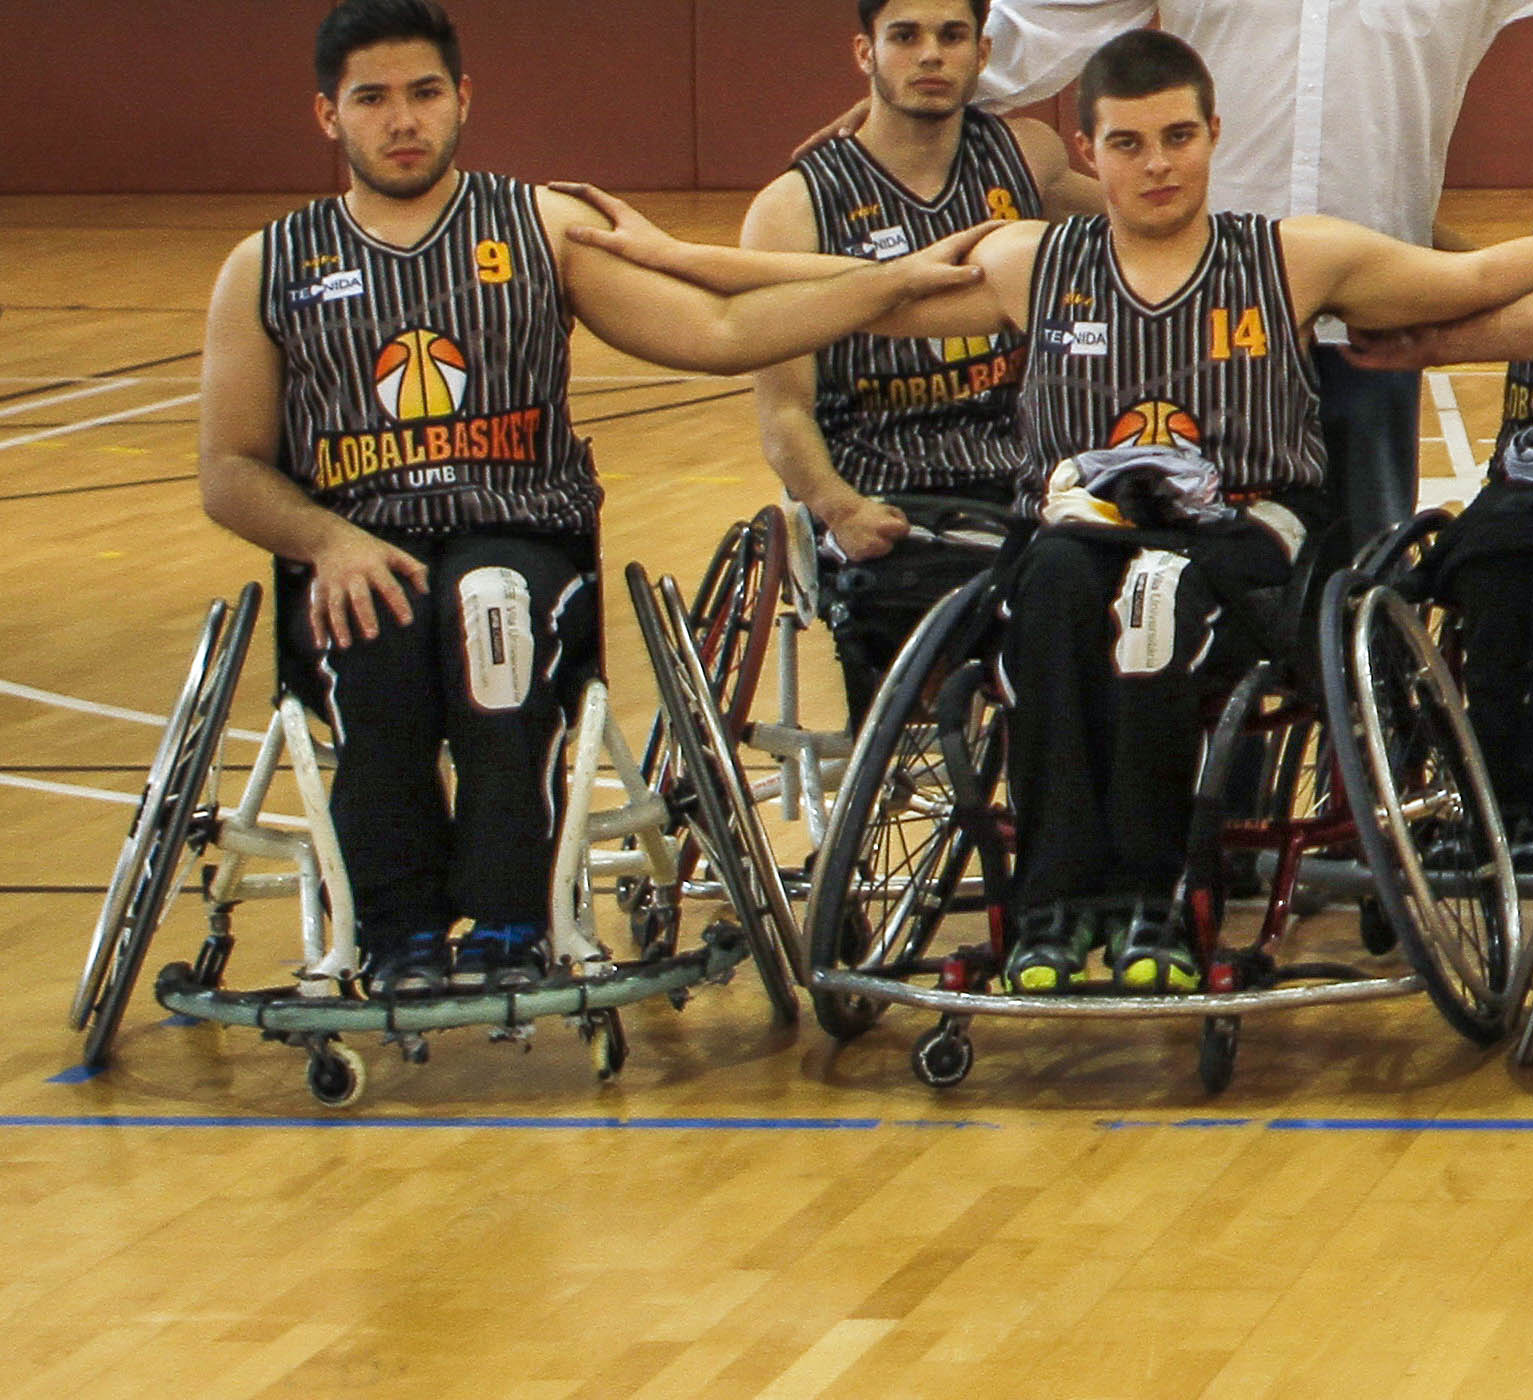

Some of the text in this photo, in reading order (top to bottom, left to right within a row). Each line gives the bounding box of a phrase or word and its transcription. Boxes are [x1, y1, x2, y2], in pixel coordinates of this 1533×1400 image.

[987, 187, 1020, 221] 8
[476, 238, 513, 284] 9
[1208, 306, 1268, 361] 14
